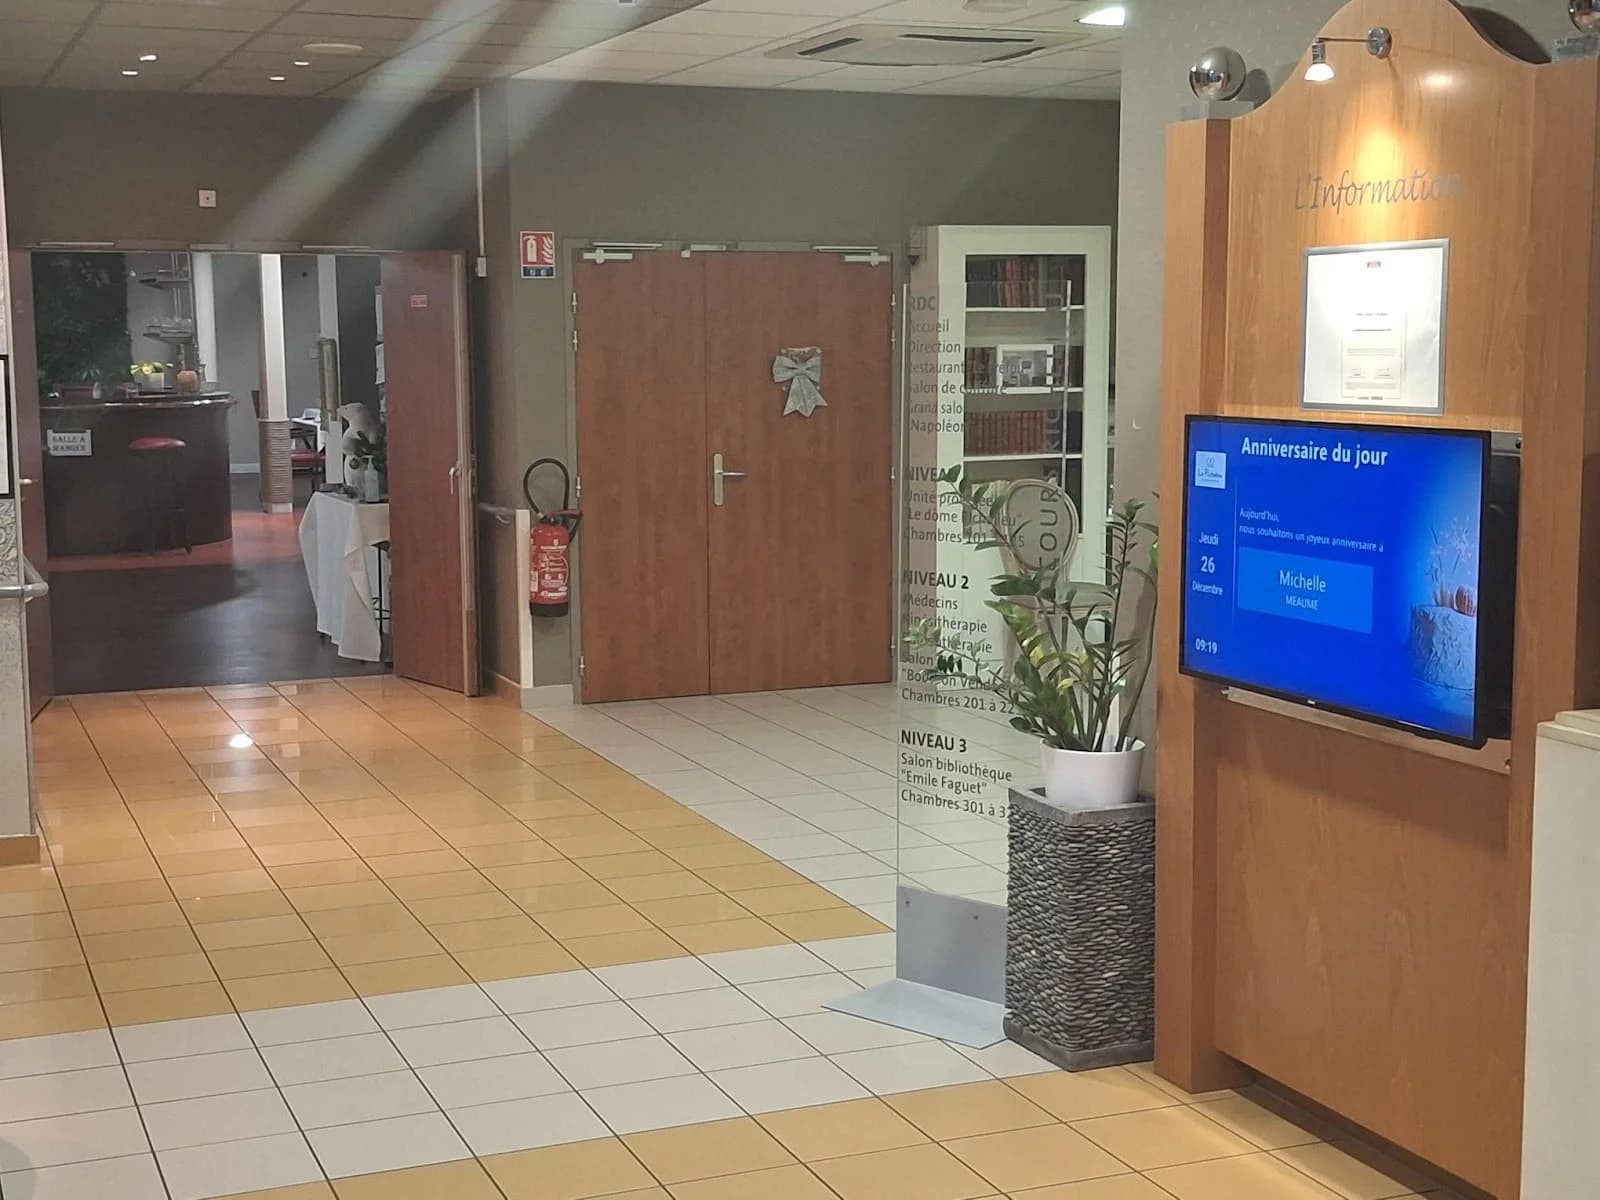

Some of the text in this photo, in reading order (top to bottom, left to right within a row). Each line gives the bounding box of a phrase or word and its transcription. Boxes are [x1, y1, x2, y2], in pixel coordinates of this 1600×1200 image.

[941, 380, 957, 394] de
[1241, 436, 1389, 470] Anniversaire du jour
[1198, 531, 1219, 546] Jeudi
[1239, 525, 1256, 535] nous
[1256, 527, 1294, 540] souhaitons
[1295, 533, 1305, 541] un
[1305, 534, 1330, 545] joyeux
[1331, 537, 1377, 552] anniversaire
[1201, 555, 1216, 574] 26
[902, 570, 969, 590] NIVEAU 2
[1192, 580, 1224, 597] Décembre
[1279, 569, 1327, 593] Michelle
[1195, 638, 1218, 655] 09:19
[901, 687, 960, 707] Chambres
[963, 696, 985, 711] 201
[901, 729, 967, 753] NIVEAU 3
[901, 752, 1012, 784] Salon bibliothèque
[901, 768, 987, 795] "Emile Faguet"
[901, 788, 960, 810] Chambres
[963, 799, 985, 815] 301
